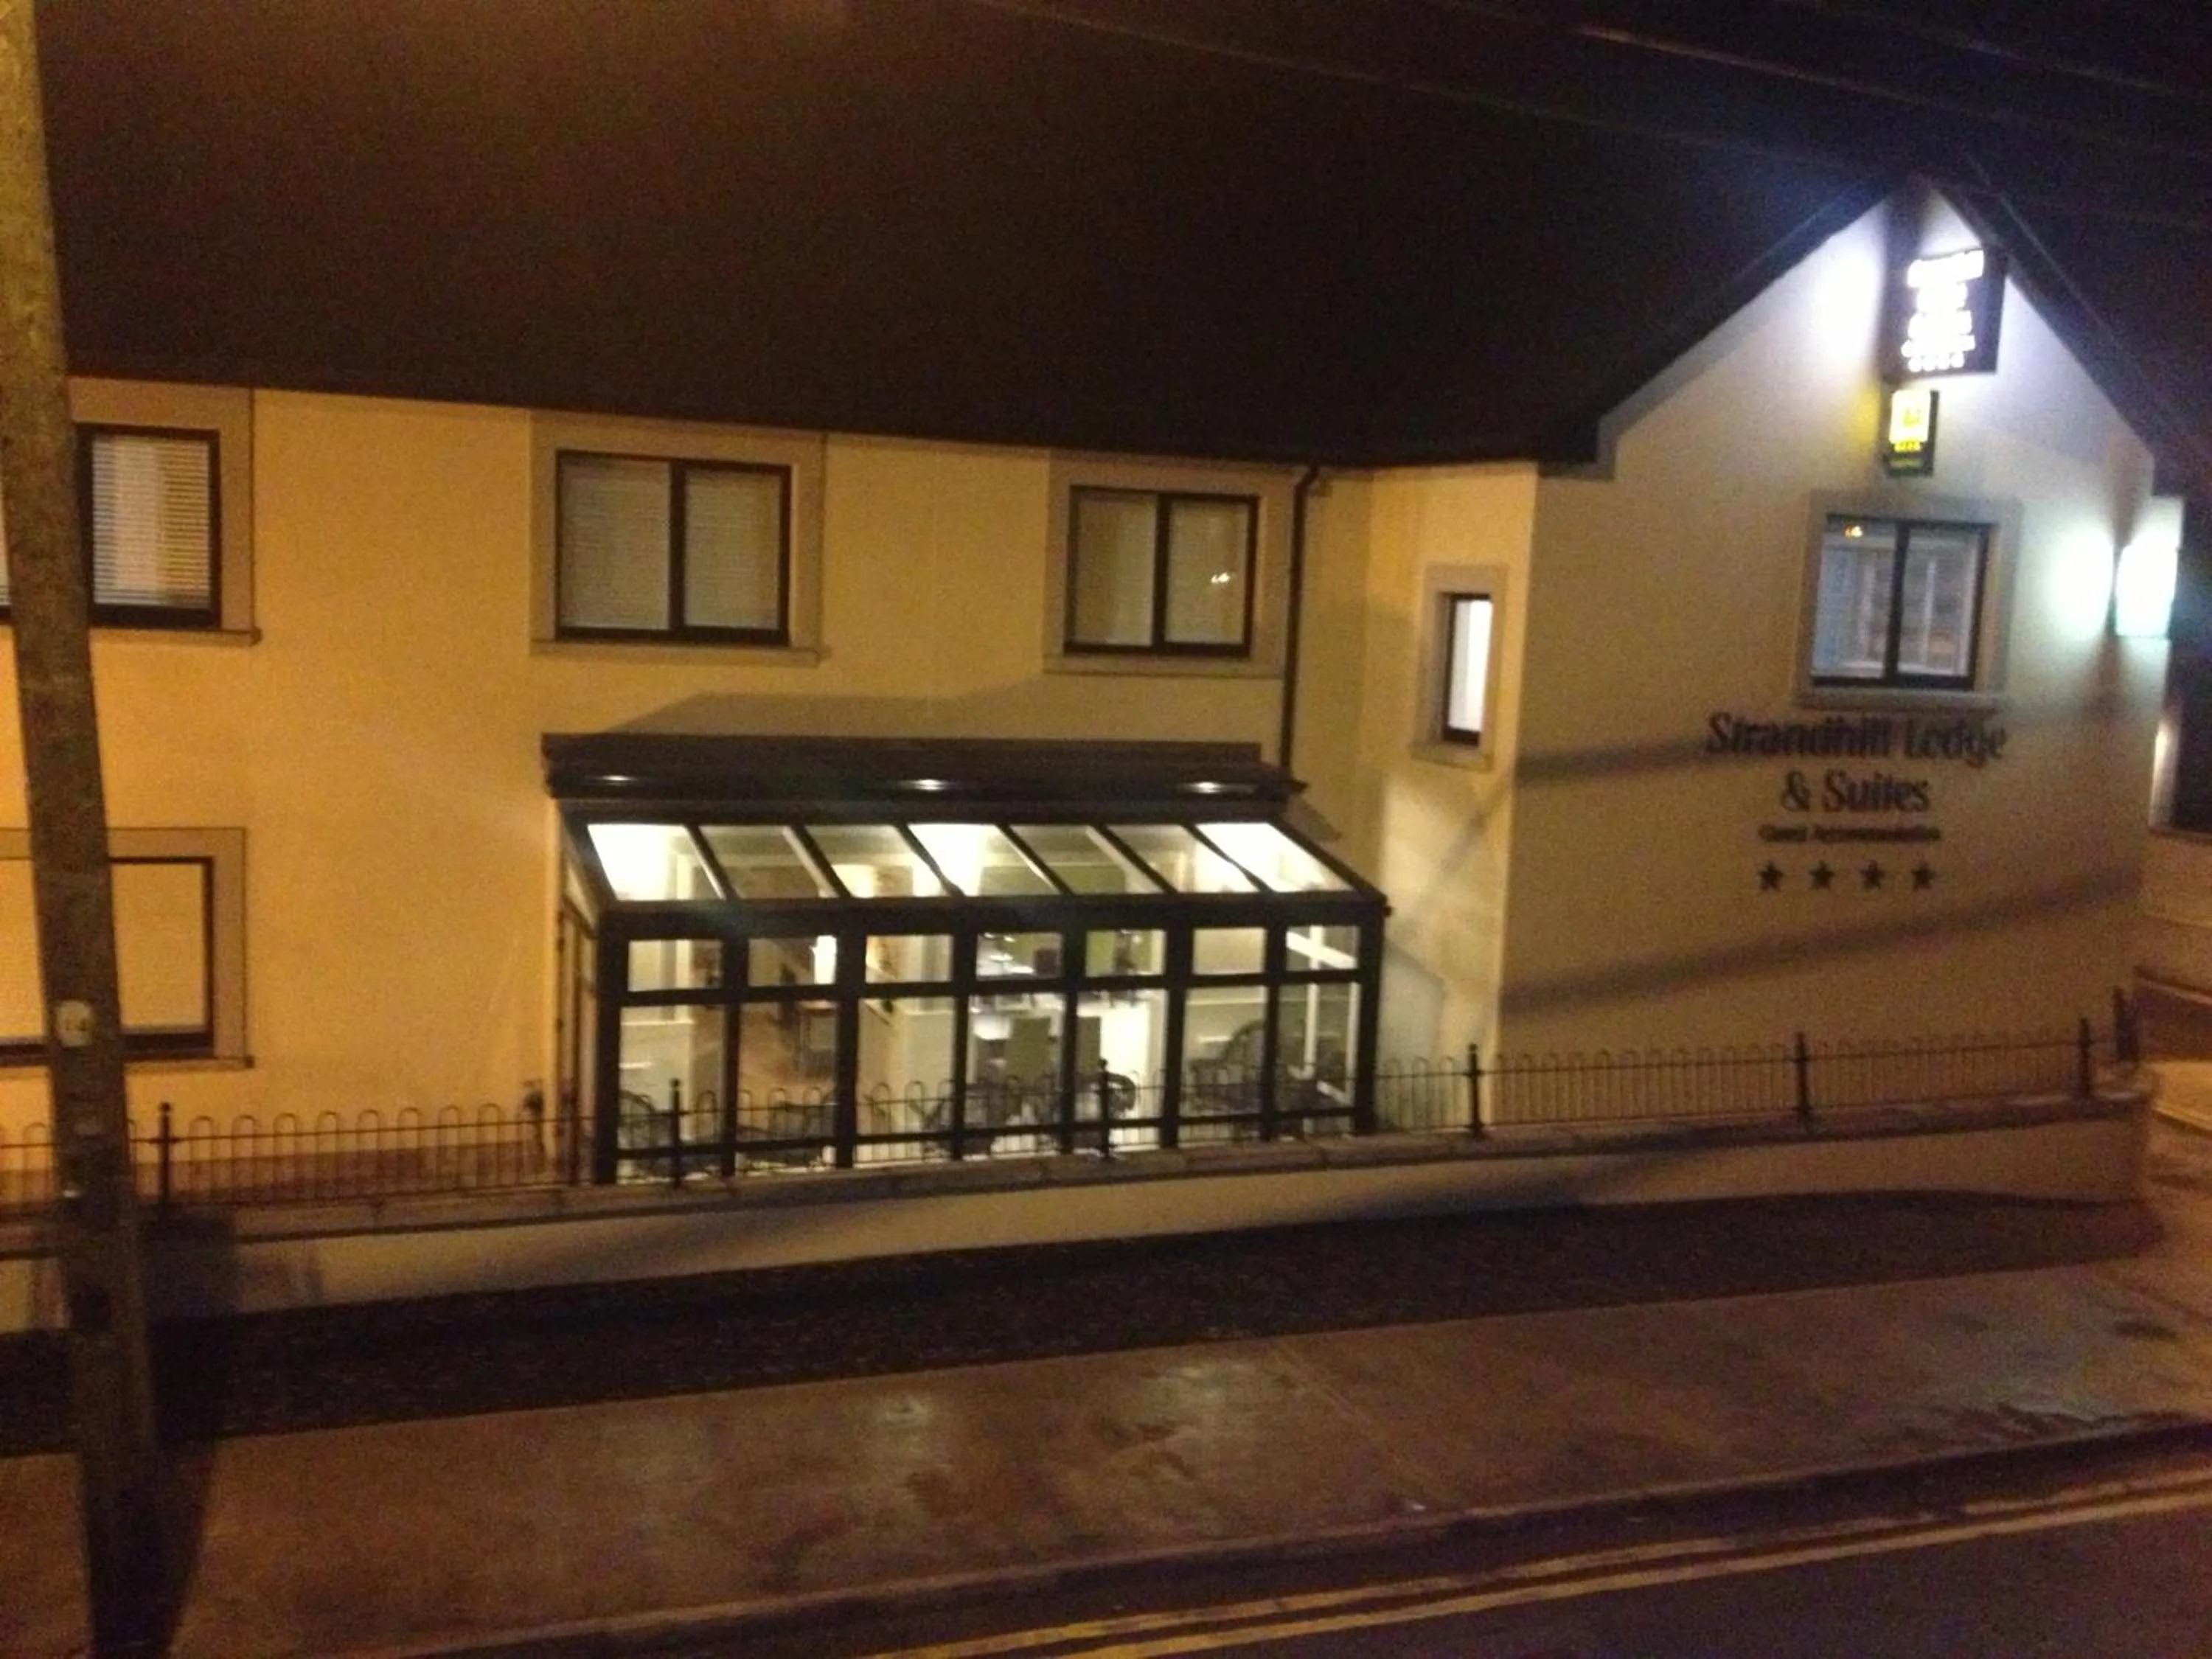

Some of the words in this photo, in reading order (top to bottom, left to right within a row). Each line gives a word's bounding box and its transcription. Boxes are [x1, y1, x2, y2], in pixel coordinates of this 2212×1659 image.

[1705, 711, 1893, 758] Strandhill
[1904, 715, 2007, 769] Lodge
[1781, 769, 1810, 811] &
[1822, 769, 1930, 812] Suites
